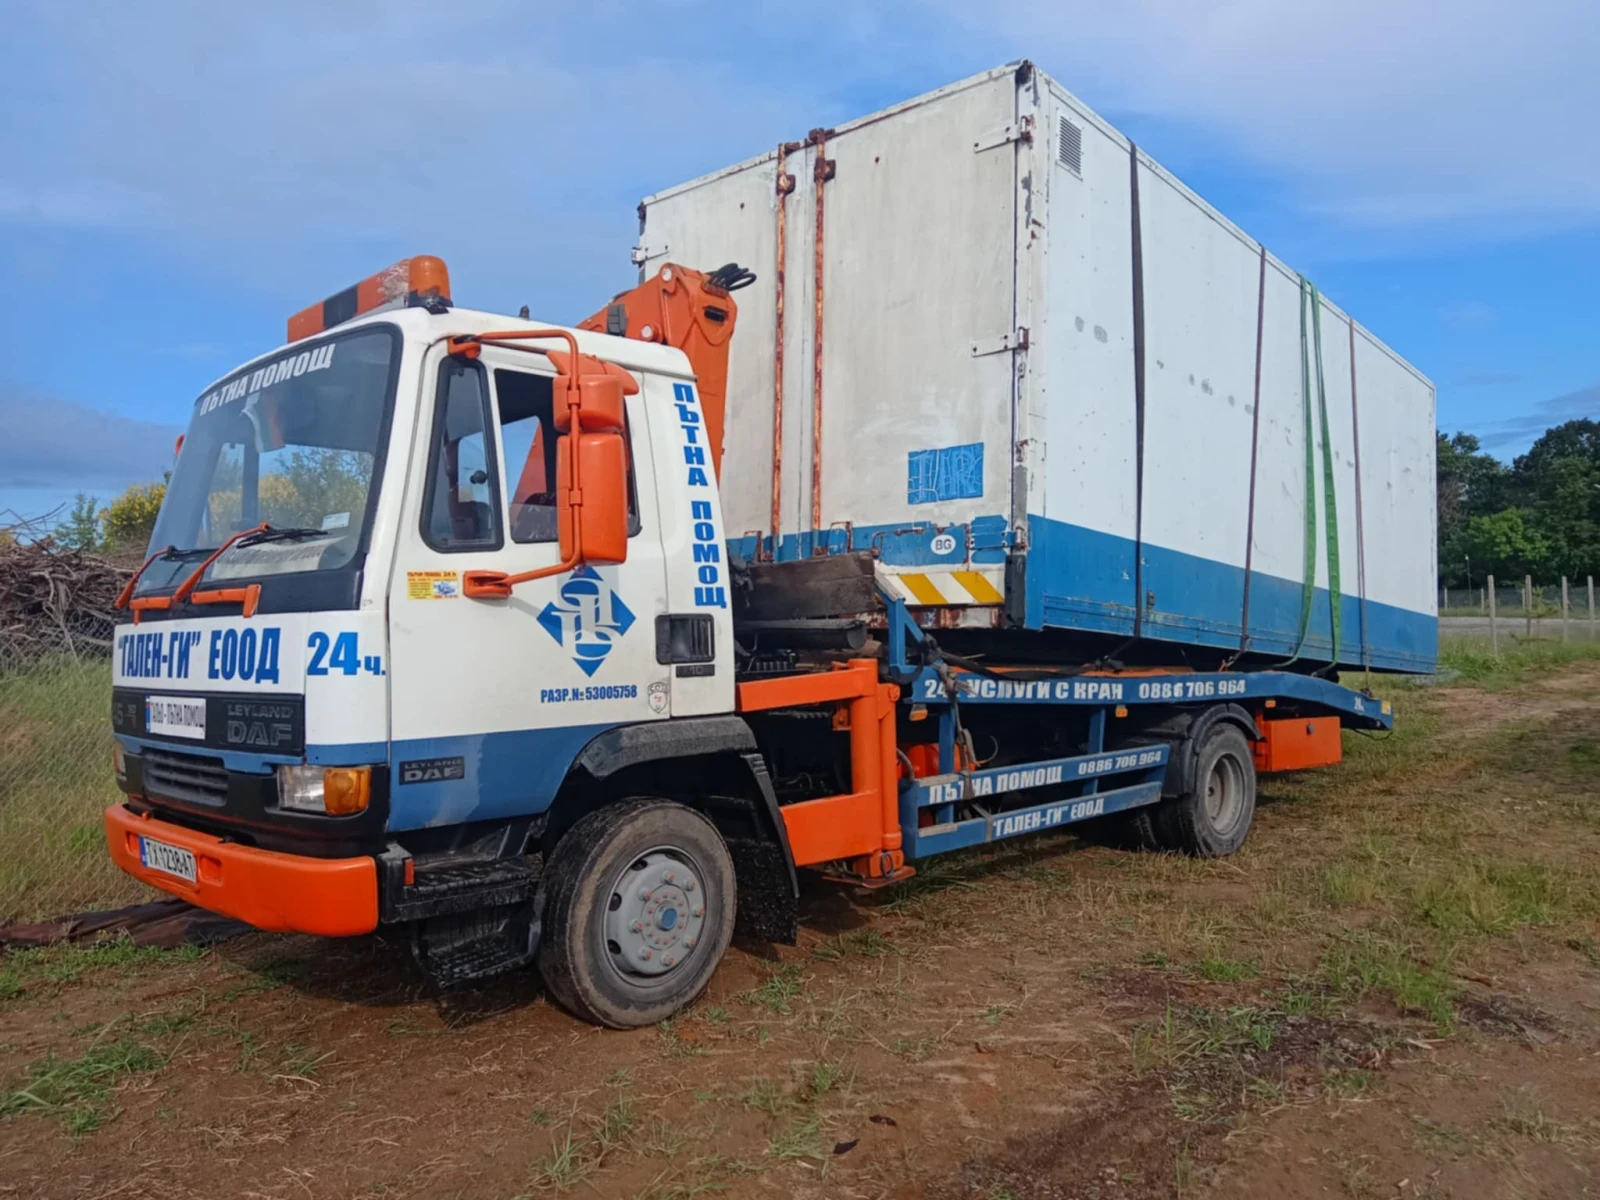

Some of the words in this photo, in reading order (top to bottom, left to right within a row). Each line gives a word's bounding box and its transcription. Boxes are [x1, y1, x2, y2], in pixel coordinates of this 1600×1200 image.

[200, 375, 250, 416] ПЪТНА
[249, 343, 336, 394] ПОМОЩ
[673, 383, 708, 486] ПЪТНА
[691, 501, 727, 609] ПОМОЩ
[935, 538, 952, 551] BG
[208, 627, 281, 684] ЕООД
[1055, 682, 1068, 699] С
[1074, 682, 1123, 700] КРАН
[1139, 682, 1184, 699] 0886
[1186, 681, 1214, 697] 706
[1218, 679, 1246, 695] 964
[227, 704, 293, 718] LEYLAND
[227, 720, 292, 746] DAF
[1078, 758, 1112, 775] 0886
[1115, 755, 1137, 769] 706
[1139, 750, 1162, 764] 964
[996, 765, 1062, 794] ПОМОЩ
[1071, 798, 1104, 819] ЕООД
